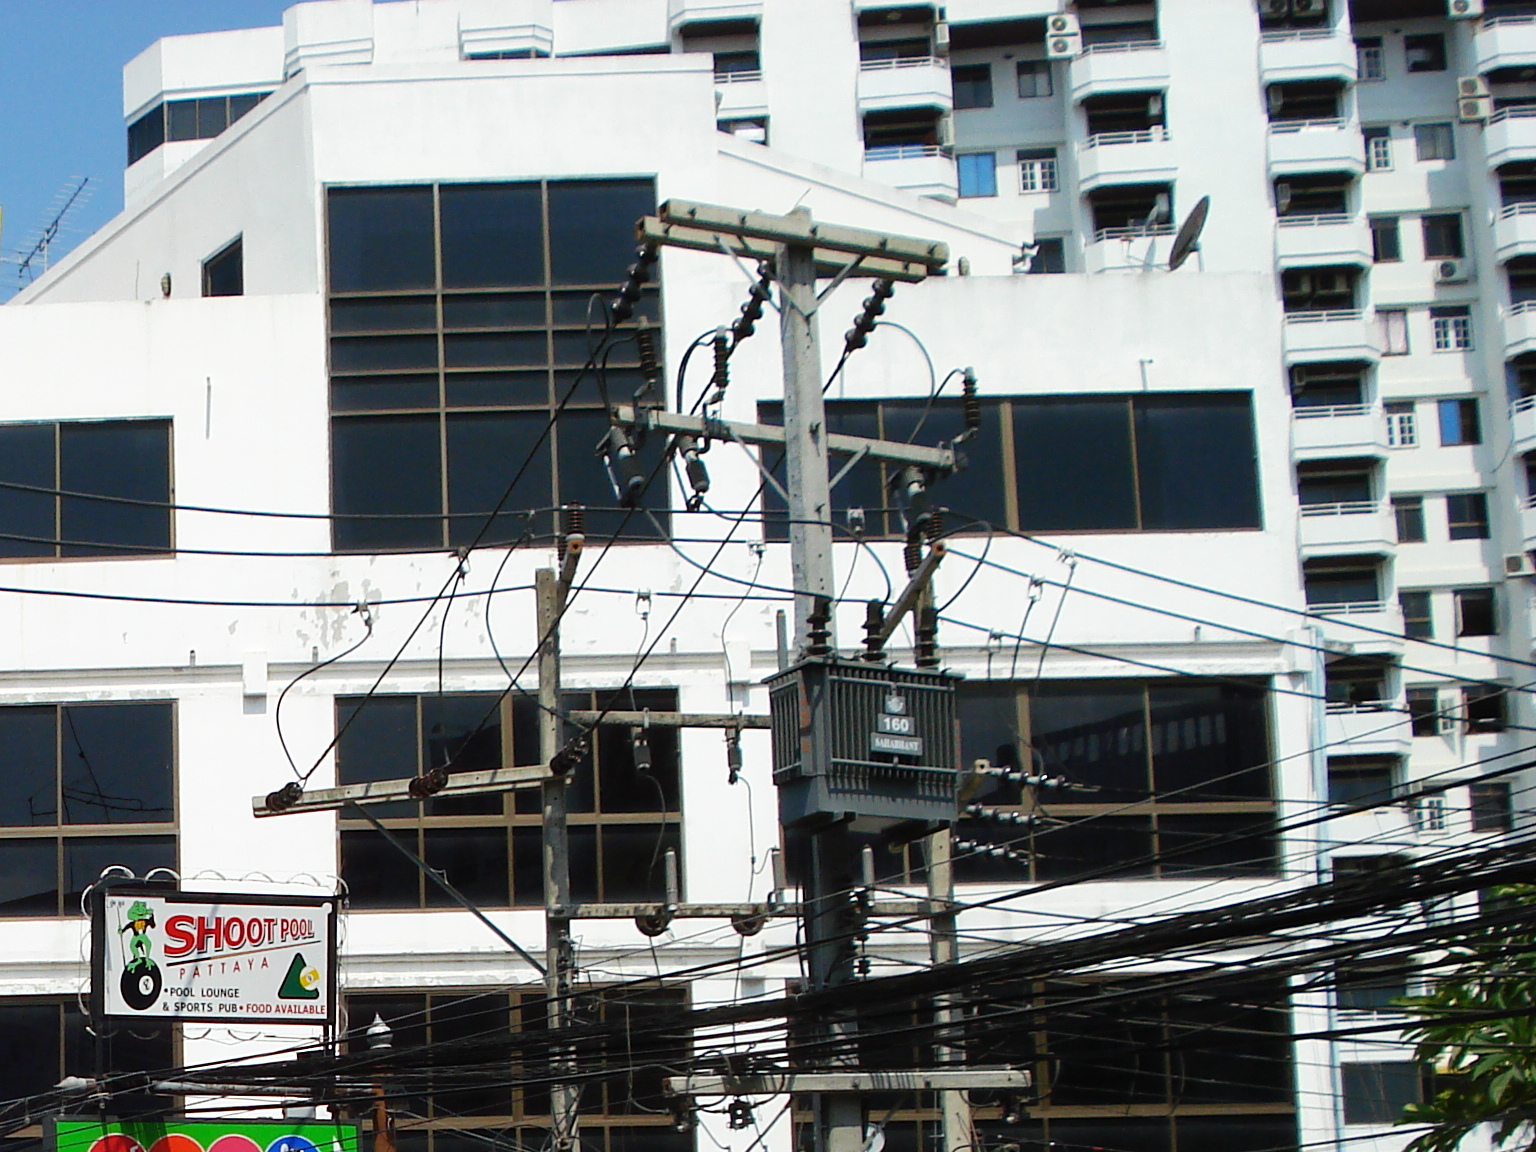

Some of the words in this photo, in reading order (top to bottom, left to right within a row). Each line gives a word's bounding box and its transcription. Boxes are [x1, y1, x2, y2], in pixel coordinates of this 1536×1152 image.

[884, 717, 909, 732] 160
[163, 914, 277, 957] SHOOT
[280, 918, 314, 942] POOL
[179, 957, 270, 980] PATTAYA
[170, 987, 195, 998] POOL
[201, 988, 240, 999] LOUNGE
[163, 1001, 170, 1012] &
[174, 1002, 213, 1012] SPORTS
[219, 1003, 238, 1012] PUB
[246, 1003, 272, 1013] FOOD
[274, 1004, 326, 1015] AVAILABLE
